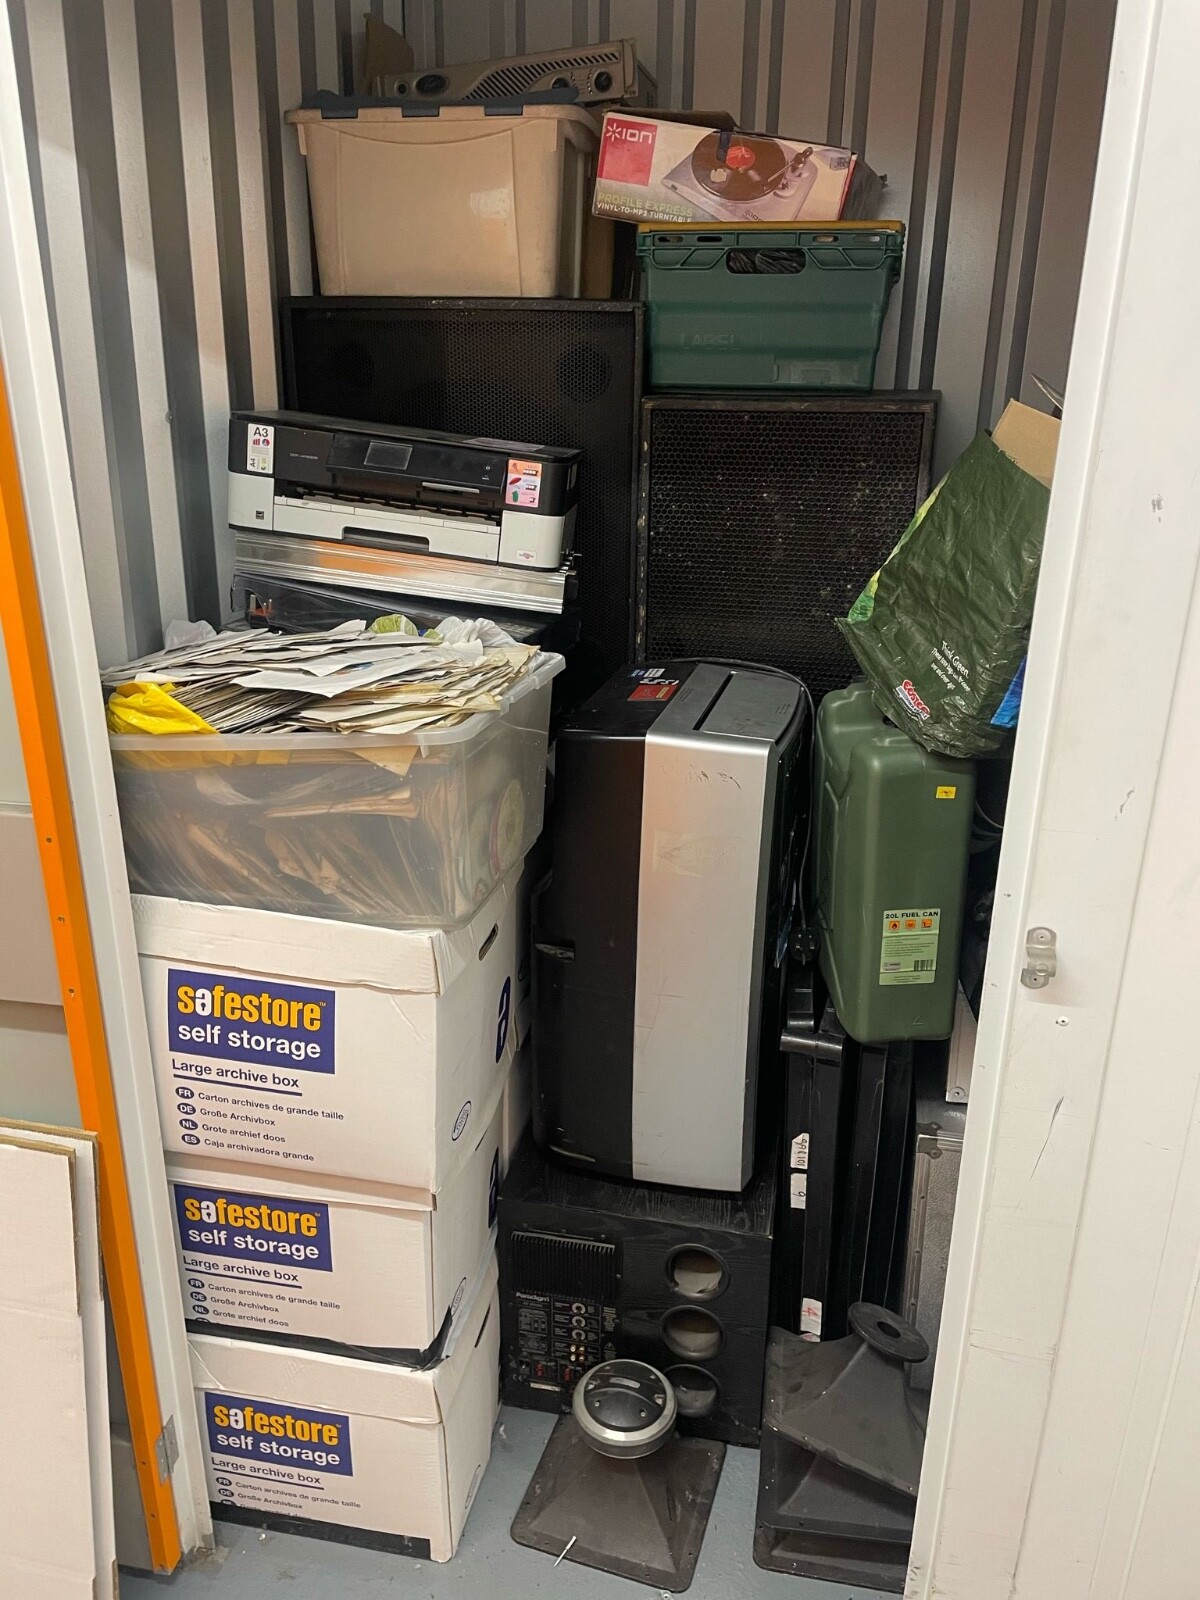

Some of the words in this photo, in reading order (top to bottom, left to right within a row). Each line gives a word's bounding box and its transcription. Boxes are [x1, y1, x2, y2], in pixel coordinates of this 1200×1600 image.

[597, 202, 648, 216] VINYL-TO-MP3
[598, 193, 642, 208] PROFILE
[645, 201, 693, 216] EXPRESS
[254, 427, 268, 438] A3
[178, 1024, 221, 1044] self
[228, 1030, 320, 1060] storage
[172, 1058, 212, 1075] Large
[216, 1069, 268, 1084] archive
[273, 1074, 299, 1088] box
[178, 1089, 191, 1098] FR
[198, 1092, 229, 1104] Carton
[232, 1098, 270, 1110] archives
[272, 1104, 284, 1112] de
[286, 1107, 318, 1116] grande
[322, 1110, 344, 1120] taille
[180, 1105, 193, 1113] DE
[200, 1108, 228, 1118] Große
[230, 1112, 276, 1126] Archivbox
[182, 1120, 195, 1128] NL
[202, 1124, 227, 1134] Grote
[230, 1128, 260, 1139] archief
[263, 1133, 286, 1142] doos
[184, 1136, 197, 1144] ES
[204, 1138, 224, 1148] Caja
[227, 1142, 280, 1156] archivadora
[282, 1150, 314, 1161] grande
[188, 1229, 227, 1246] self
[234, 1235, 319, 1260] storage
[183, 1256, 219, 1270] Large
[223, 1264, 270, 1277] archive
[274, 1270, 299, 1282] box
[191, 1280, 202, 1288] FR
[208, 1284, 236, 1293] Carton
[239, 1289, 274, 1299] archives
[276, 1294, 286, 1302] de
[288, 1297, 318, 1306] grande
[320, 1300, 340, 1310] taille
[192, 1293, 204, 1301] DE
[210, 1297, 235, 1306] Große
[238, 1301, 280, 1312] Archivbox
[195, 1306, 206, 1314] NL
[213, 1310, 236, 1319] Grote
[238, 1314, 266, 1324] archief
[268, 1318, 289, 1327] doos
[217, 1434, 253, 1450] self
[260, 1441, 340, 1466] storage
[212, 1457, 246, 1471] Large
[250, 1465, 294, 1480] archive
[298, 1472, 321, 1484] box
[236, 1482, 262, 1491] Carton
[264, 1488, 297, 1498] archives
[312, 1496, 340, 1504] grande
[342, 1500, 362, 1508] taille
[238, 1493, 261, 1502] Große
[264, 1498, 303, 1509] Archivbox
